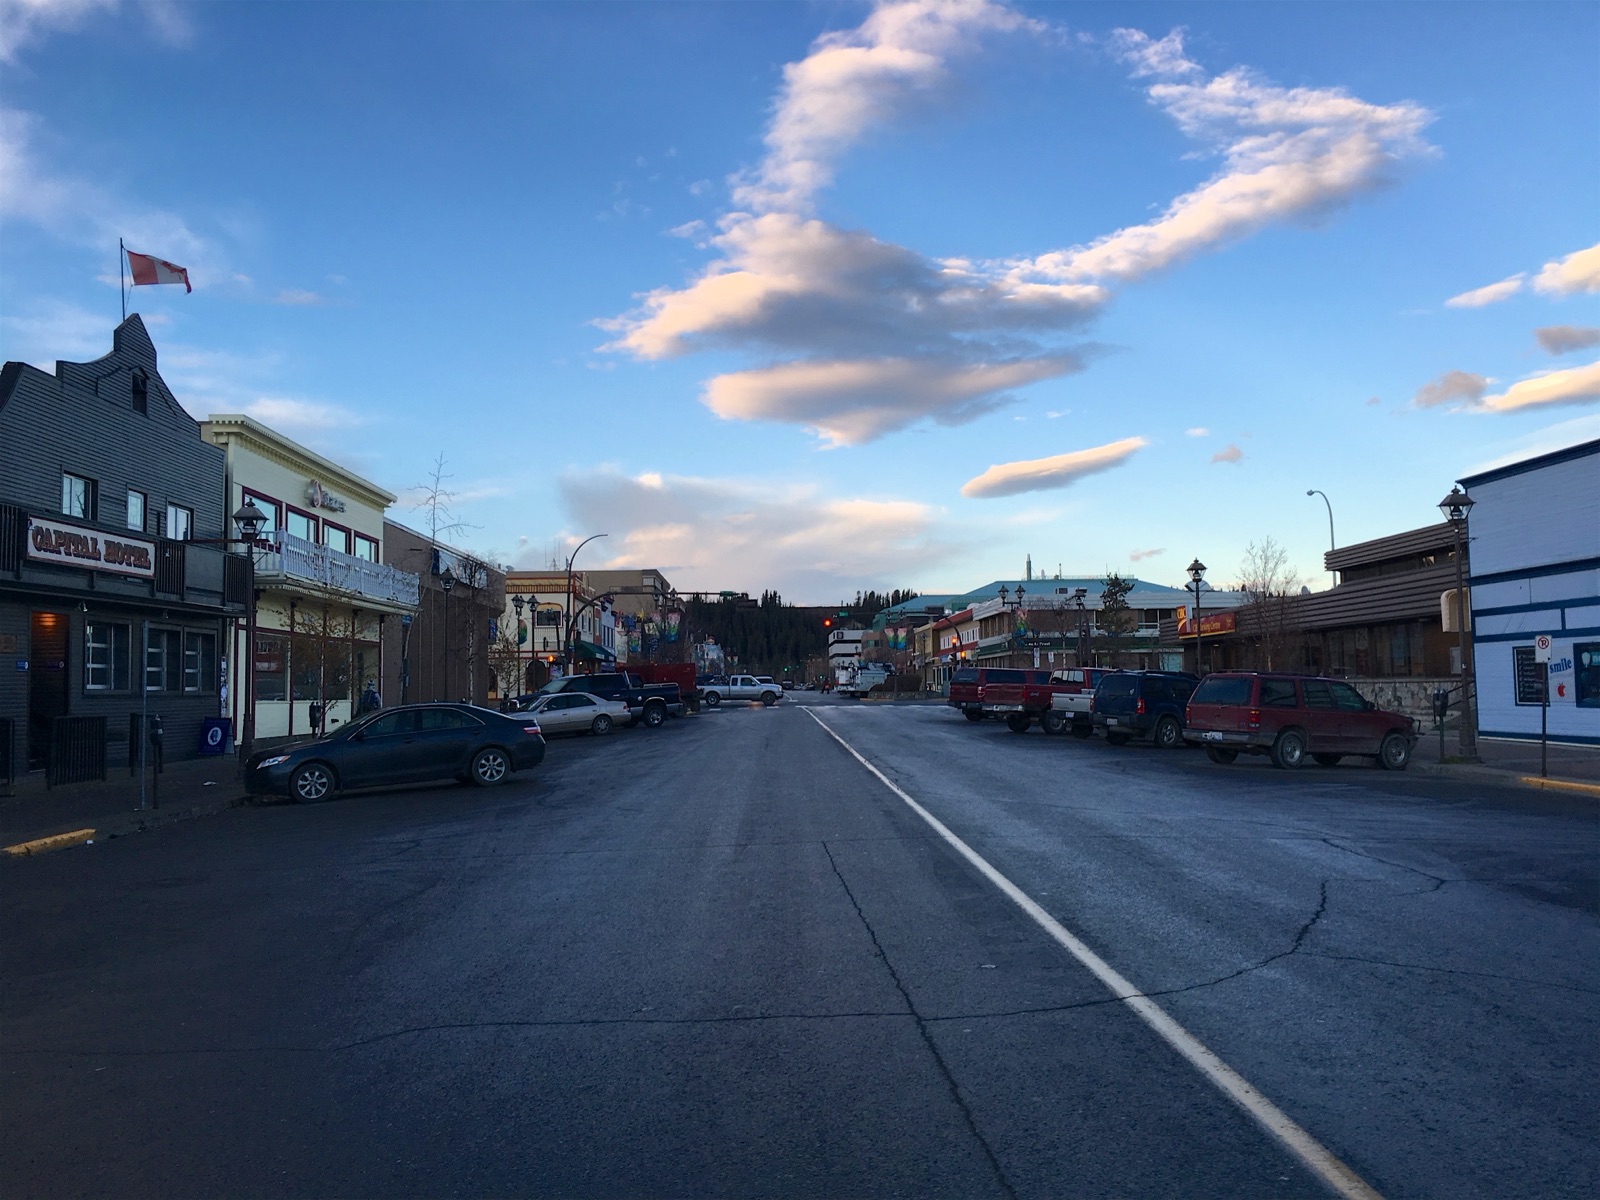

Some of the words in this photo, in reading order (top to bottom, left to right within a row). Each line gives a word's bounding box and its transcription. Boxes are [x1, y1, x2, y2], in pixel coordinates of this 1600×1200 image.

[32, 525, 101, 561] CAPITAL
[104, 540, 151, 570] HOTEL
[1549, 658, 1572, 674] smile
